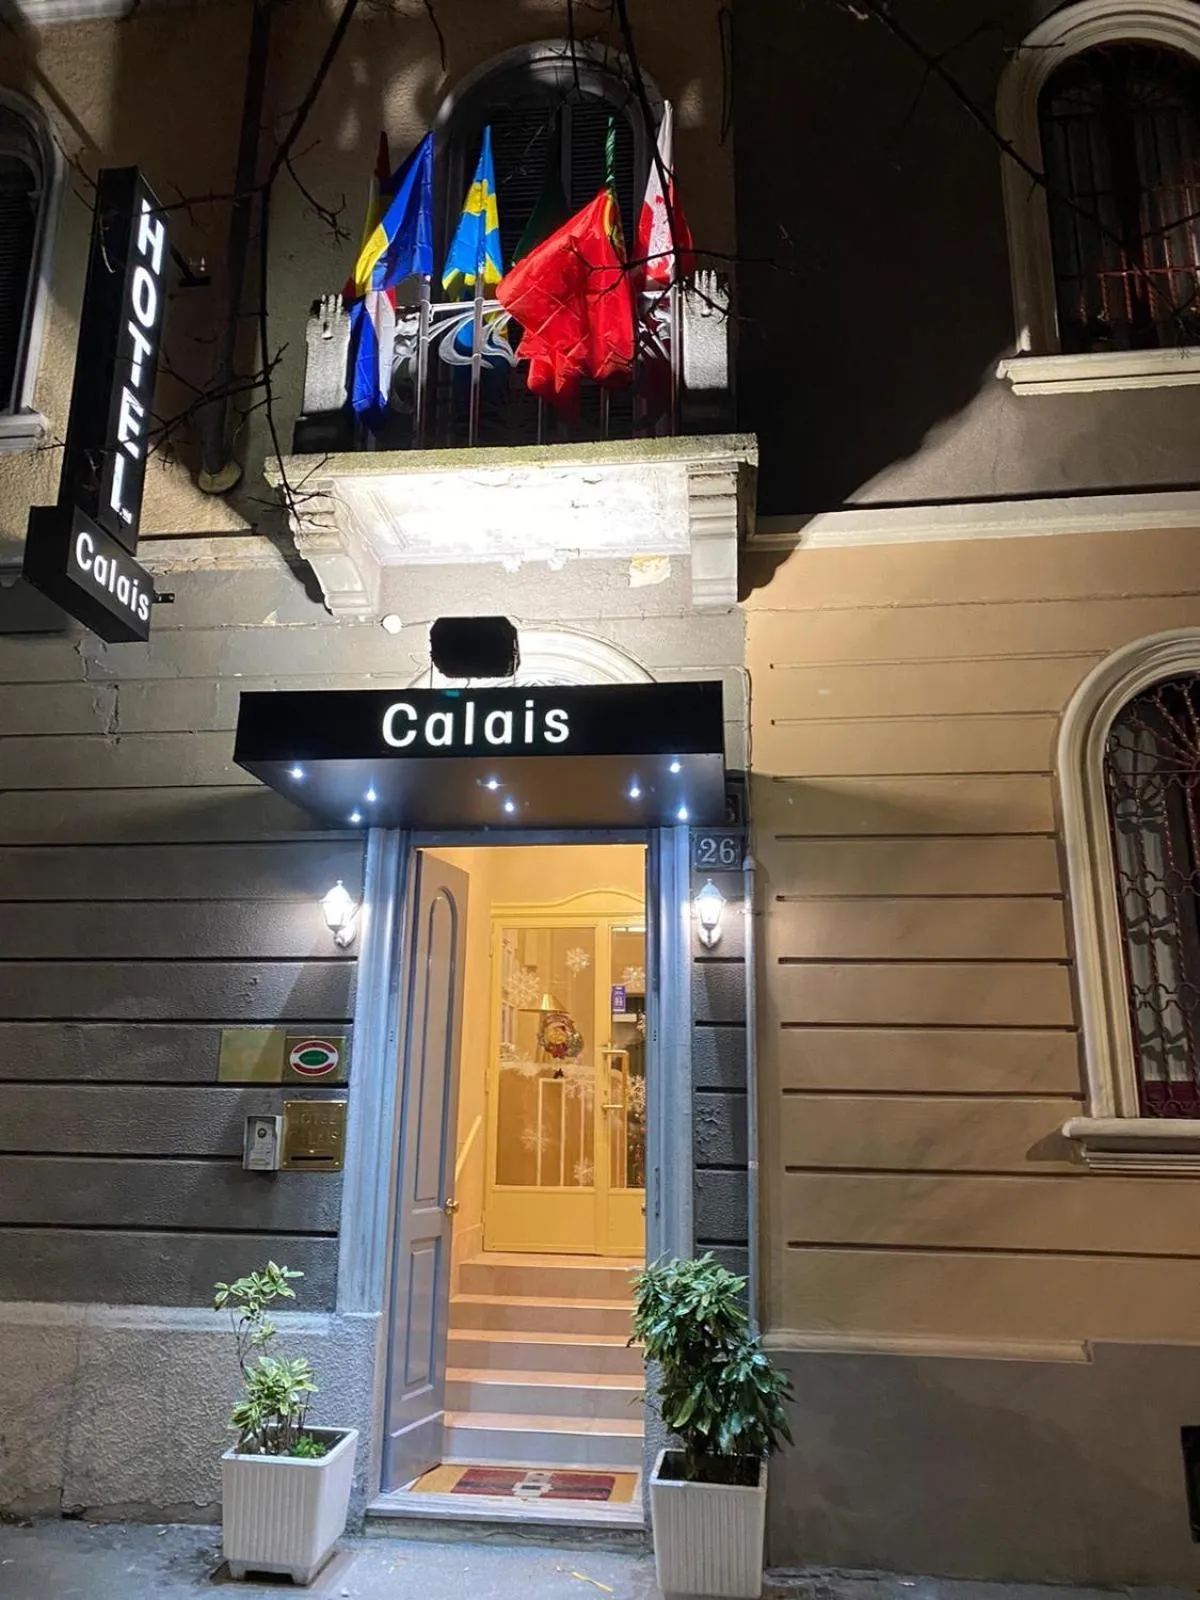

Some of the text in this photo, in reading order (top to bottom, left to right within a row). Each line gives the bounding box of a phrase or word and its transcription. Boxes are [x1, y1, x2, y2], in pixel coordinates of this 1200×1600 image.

[110, 197, 165, 525] HOTEL
[75, 531, 150, 622] Calais
[382, 699, 570, 748] Calais
[700, 838, 735, 864] 26
